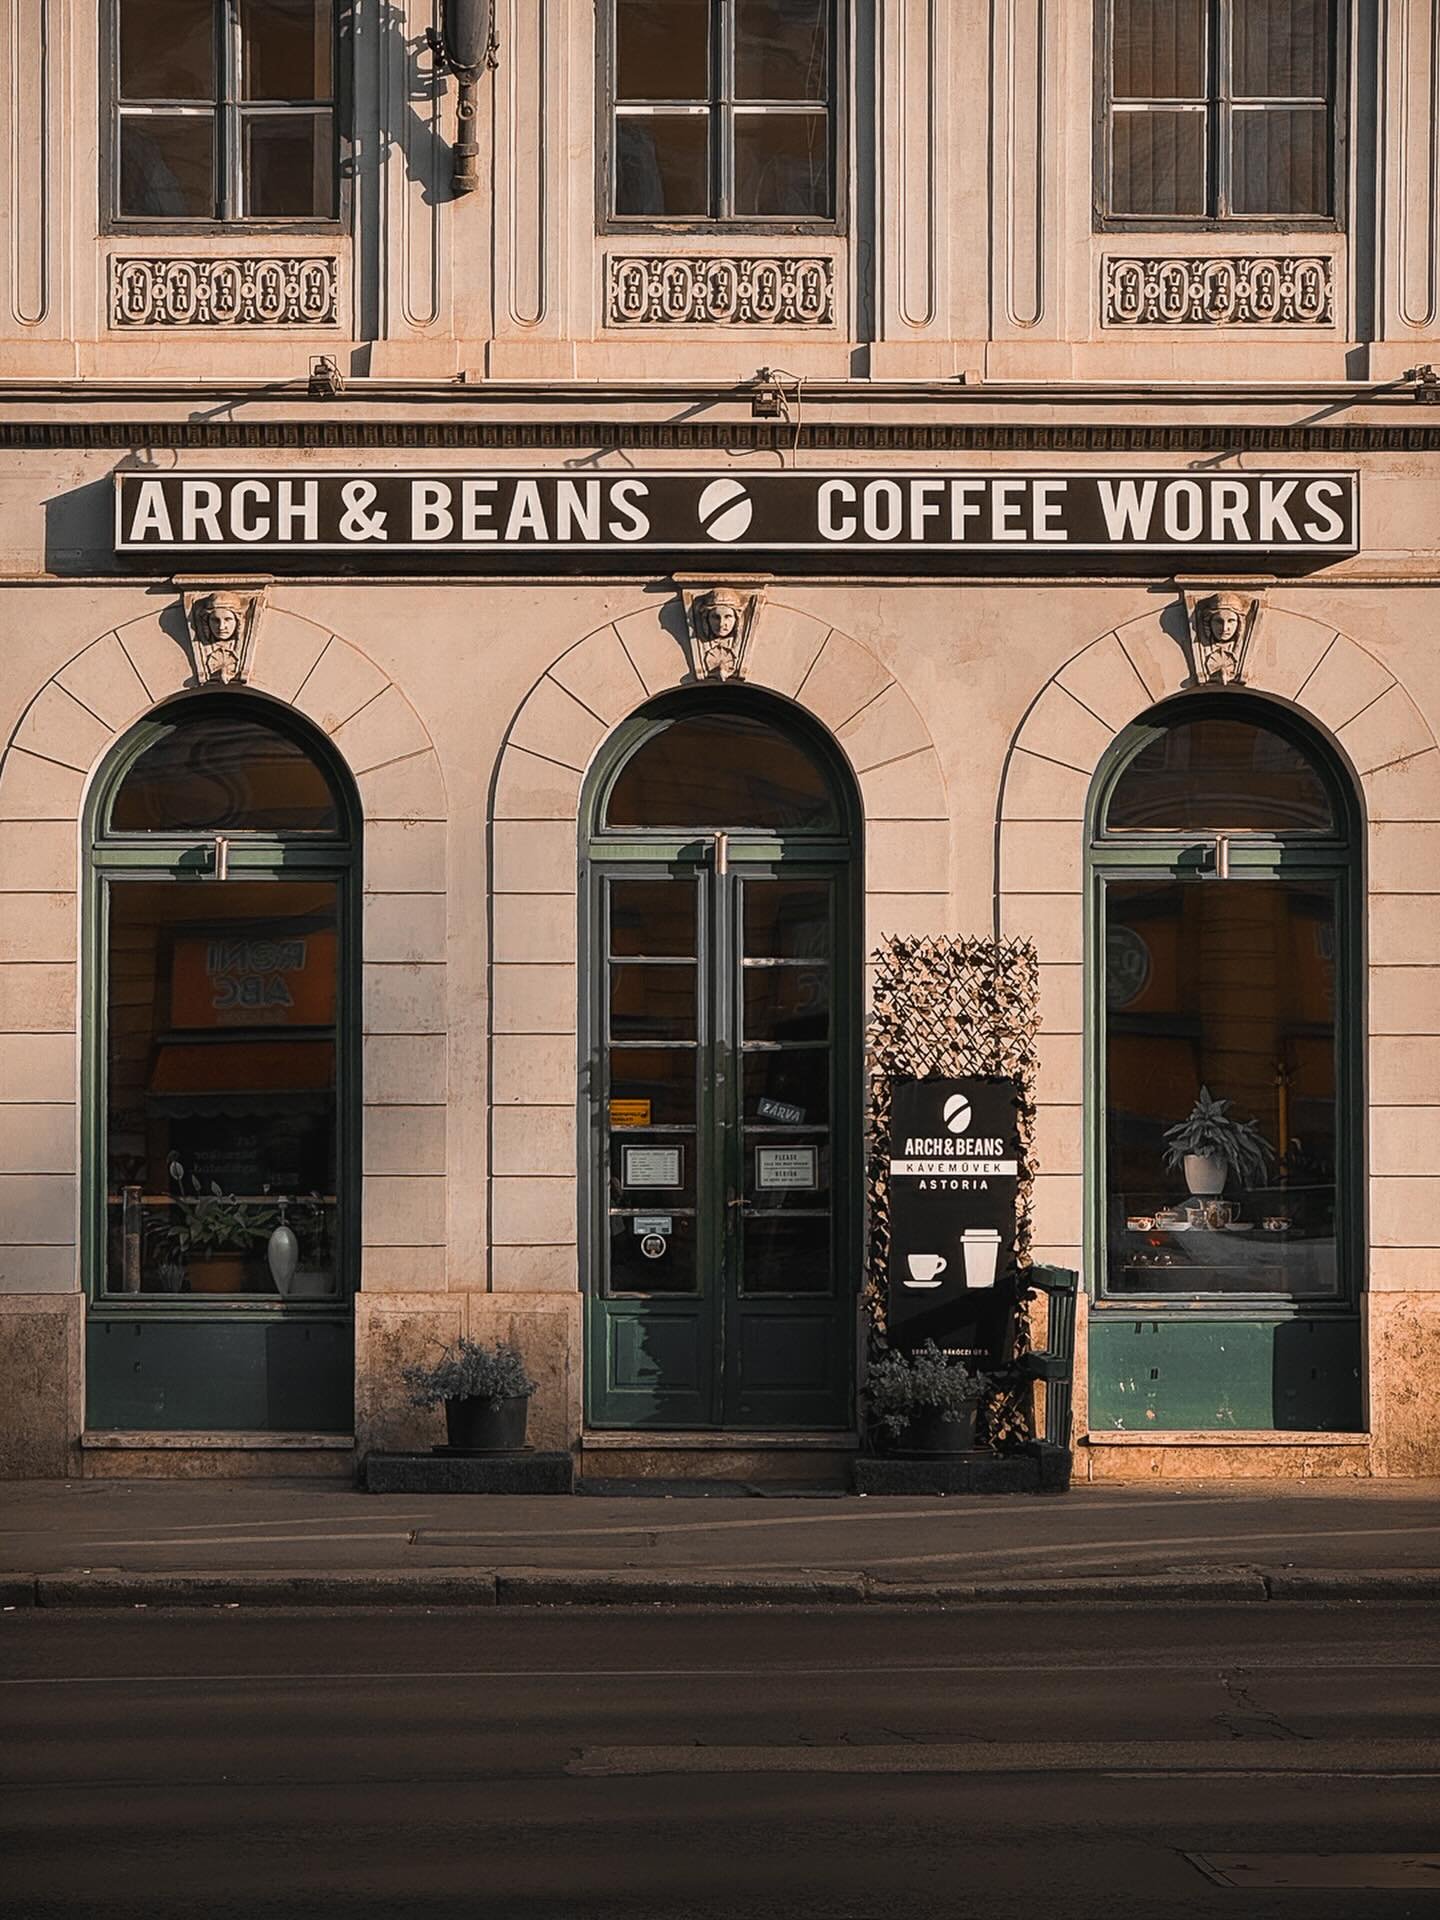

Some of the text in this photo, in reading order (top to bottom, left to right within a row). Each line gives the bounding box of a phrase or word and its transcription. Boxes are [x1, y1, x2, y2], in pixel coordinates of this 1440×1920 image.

[129, 479, 1345, 543] ARCH & BEANS COFFEE WORKS
[762, 1102, 801, 1122] ZÁRVA
[904, 1138, 1004, 1156] ARCH&BEANS
[919, 1179, 988, 1191] ASTORIA
